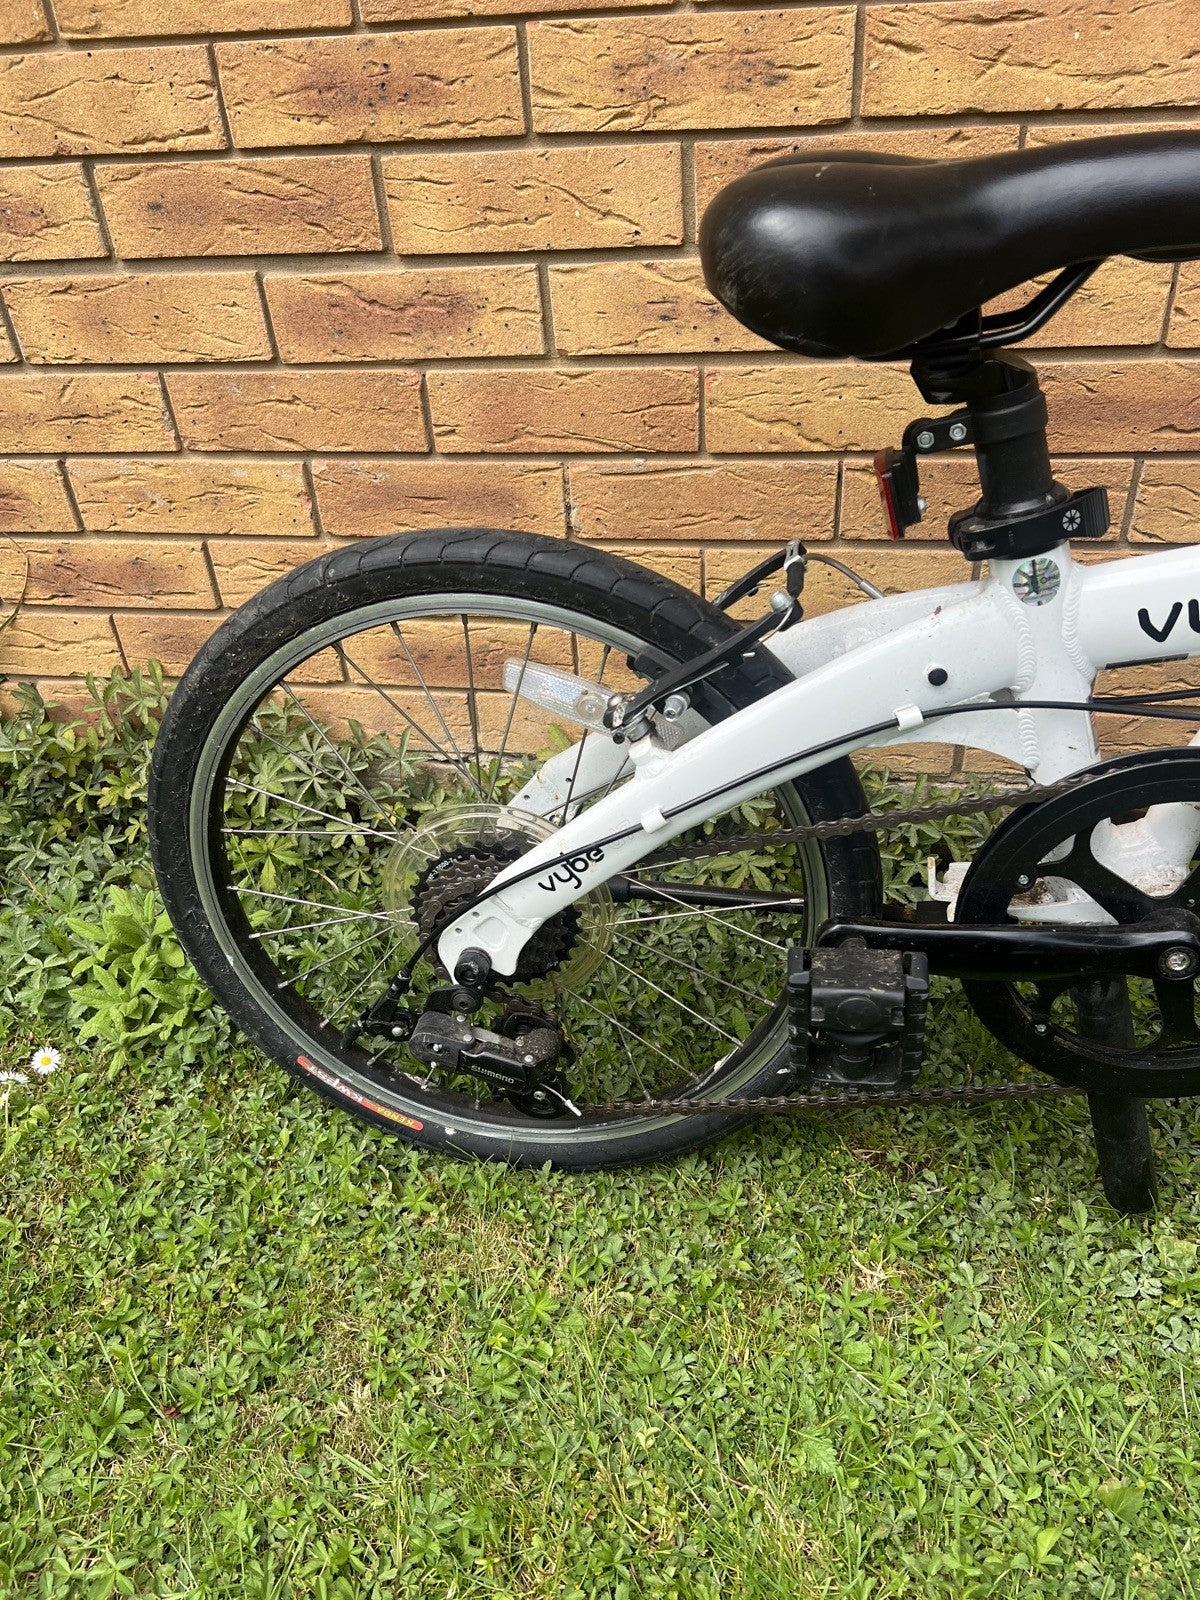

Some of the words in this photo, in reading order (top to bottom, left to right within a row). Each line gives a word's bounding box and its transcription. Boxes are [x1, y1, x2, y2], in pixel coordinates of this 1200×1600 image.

[538, 852, 605, 892] vybe
[471, 1065, 515, 1085] SHIMANO
[376, 1107, 415, 1128] KENDA
